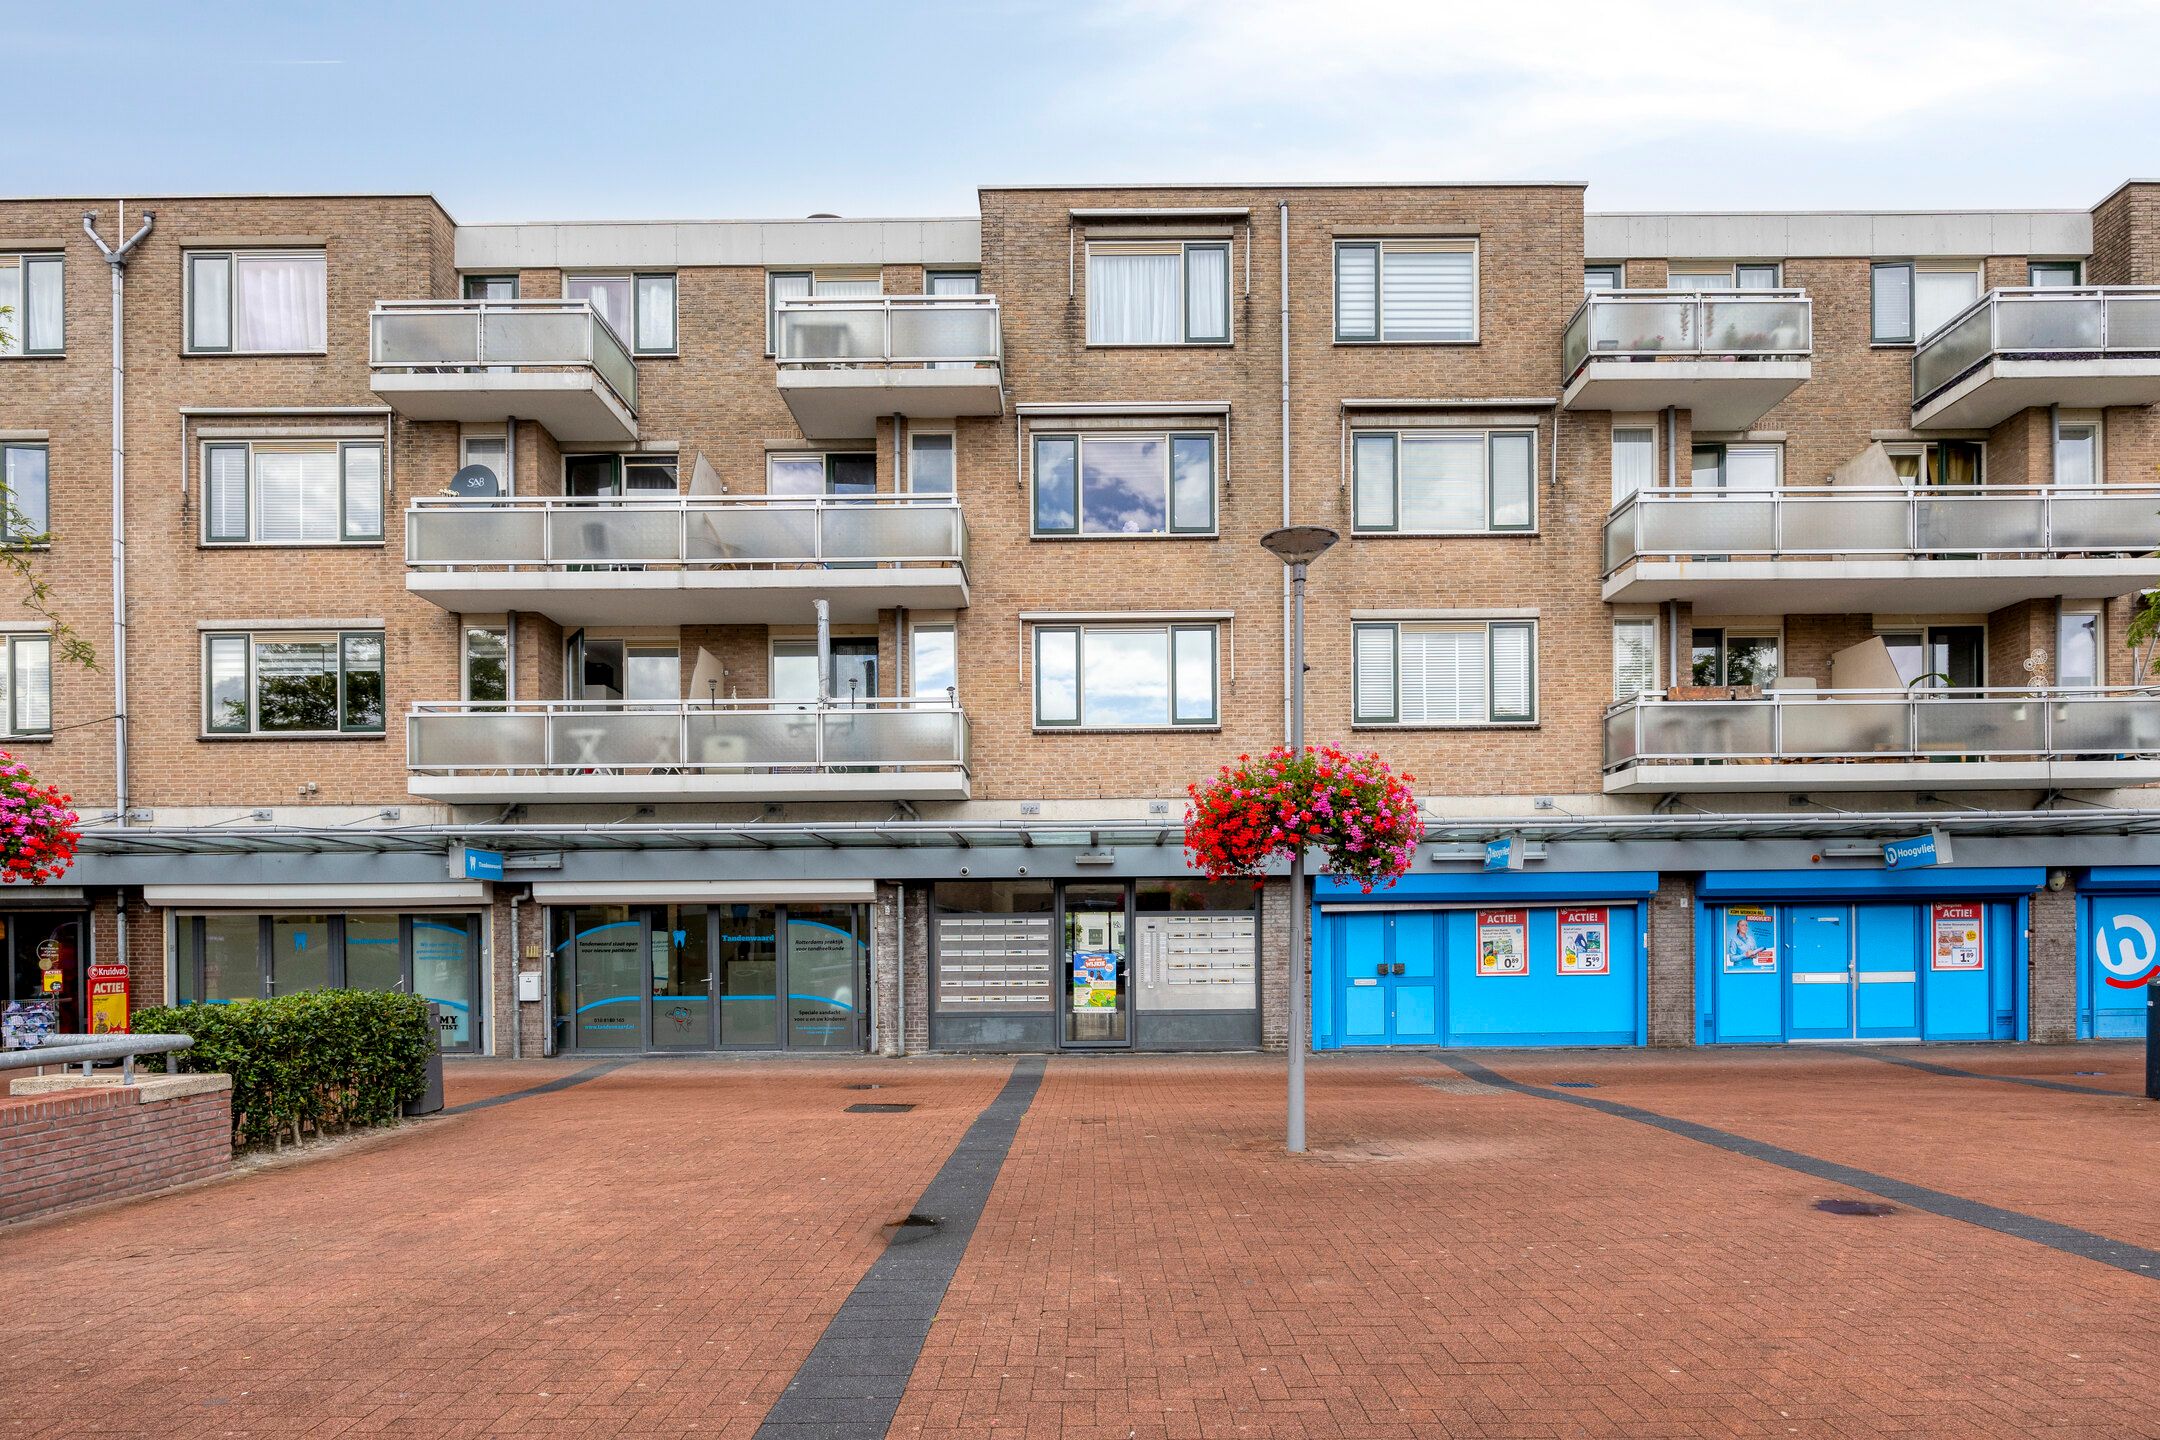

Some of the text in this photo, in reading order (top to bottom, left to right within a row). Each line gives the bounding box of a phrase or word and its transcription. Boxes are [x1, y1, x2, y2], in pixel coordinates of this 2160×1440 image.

[467, 478, 485, 487] SAB
[1897, 844, 1935, 857] Hoogvliet
[1568, 913, 1598, 922] ACTIE!
[1943, 909, 1972, 918] ACTIE!
[1487, 914, 1517, 923] ACTIE!
[721, 934, 775, 942] Tandenwaard
[98, 967, 126, 976] Kruidvat
[93, 982, 125, 993] ACTIE!
